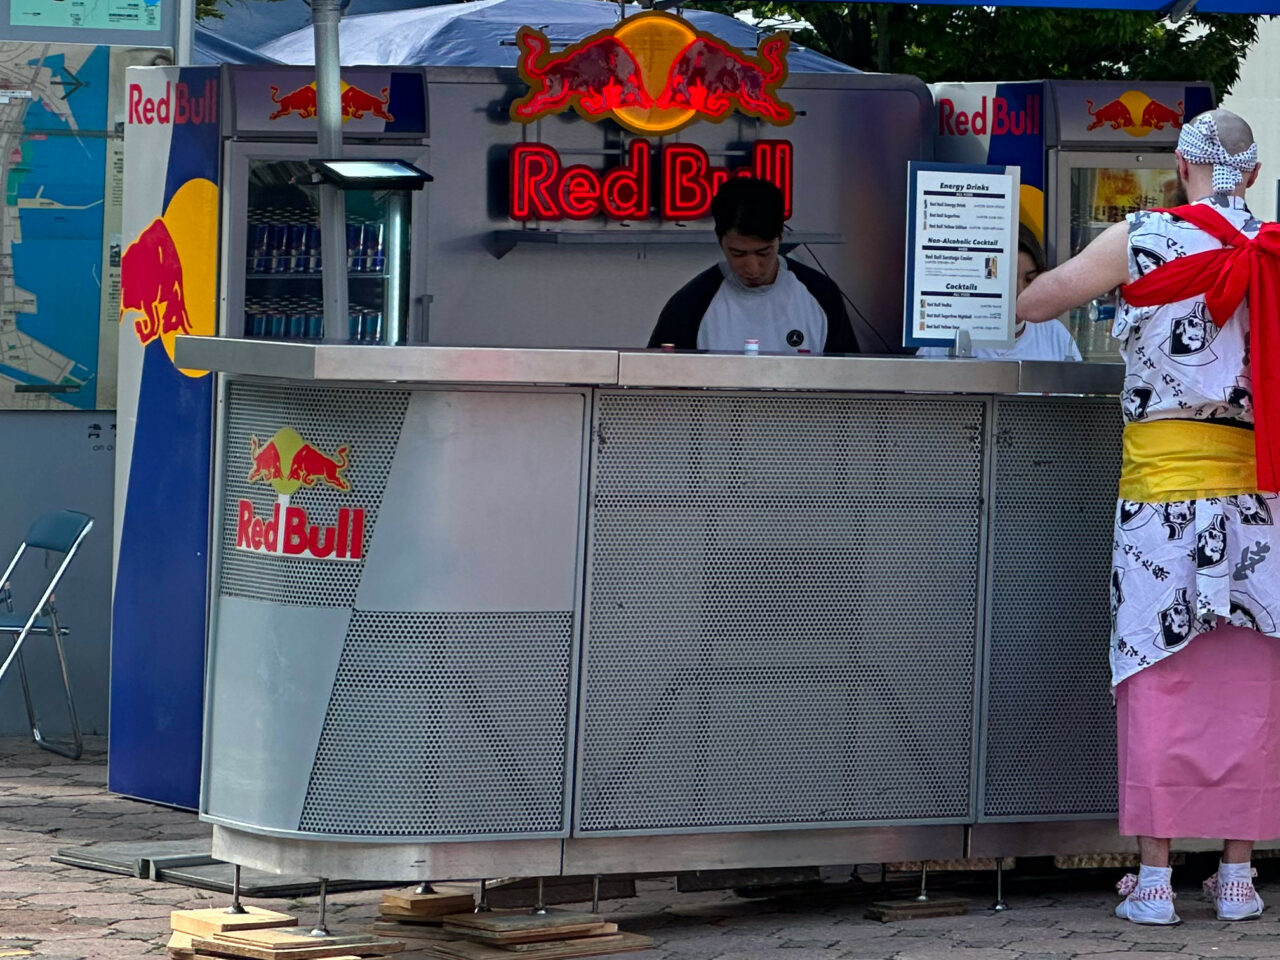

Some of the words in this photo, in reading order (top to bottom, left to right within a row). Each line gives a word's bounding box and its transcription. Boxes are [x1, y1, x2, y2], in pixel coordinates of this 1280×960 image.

[128, 81, 171, 125] Red
[173, 79, 218, 125] Bull
[938, 96, 987, 136] Red
[991, 94, 1040, 136] Bull
[510, 139, 651, 221] Red
[661, 139, 793, 221] Bll
[940, 182, 965, 192] Energy
[966, 183, 990, 191] Drinks
[927, 237, 971, 246] Non-Alcoholic
[945, 283, 978, 291] Cocktails
[236, 499, 281, 553] Red
[282, 506, 364, 560] Bull
